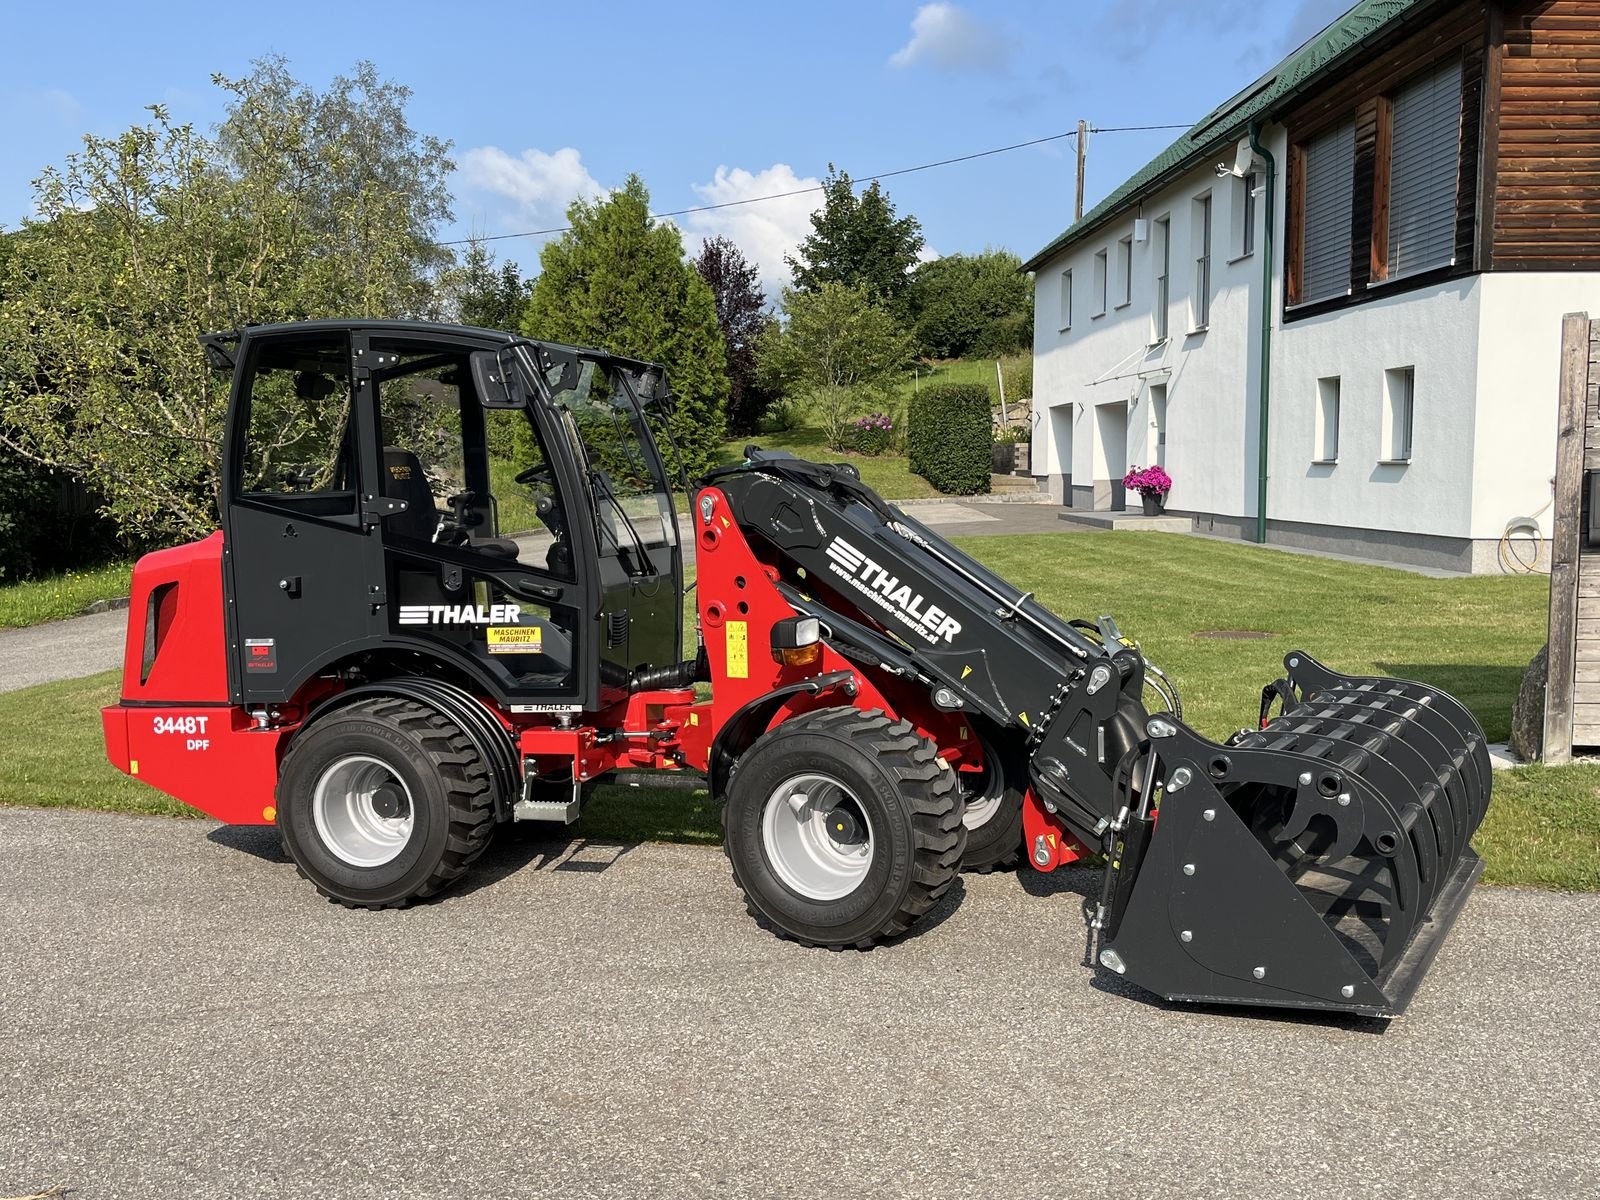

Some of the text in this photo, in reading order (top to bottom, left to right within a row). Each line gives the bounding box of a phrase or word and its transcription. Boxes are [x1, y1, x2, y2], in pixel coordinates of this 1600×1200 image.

[828, 562, 940, 645] www.maschinen-mauritz.at
[859, 557, 962, 643] THALER
[428, 604, 521, 624] THALER
[493, 628, 536, 636] MASCHINEN
[499, 635, 531, 643] MAURITZ
[153, 716, 209, 734] 3448T
[360, 725, 392, 740] POWER
[186, 739, 210, 751] DPF
